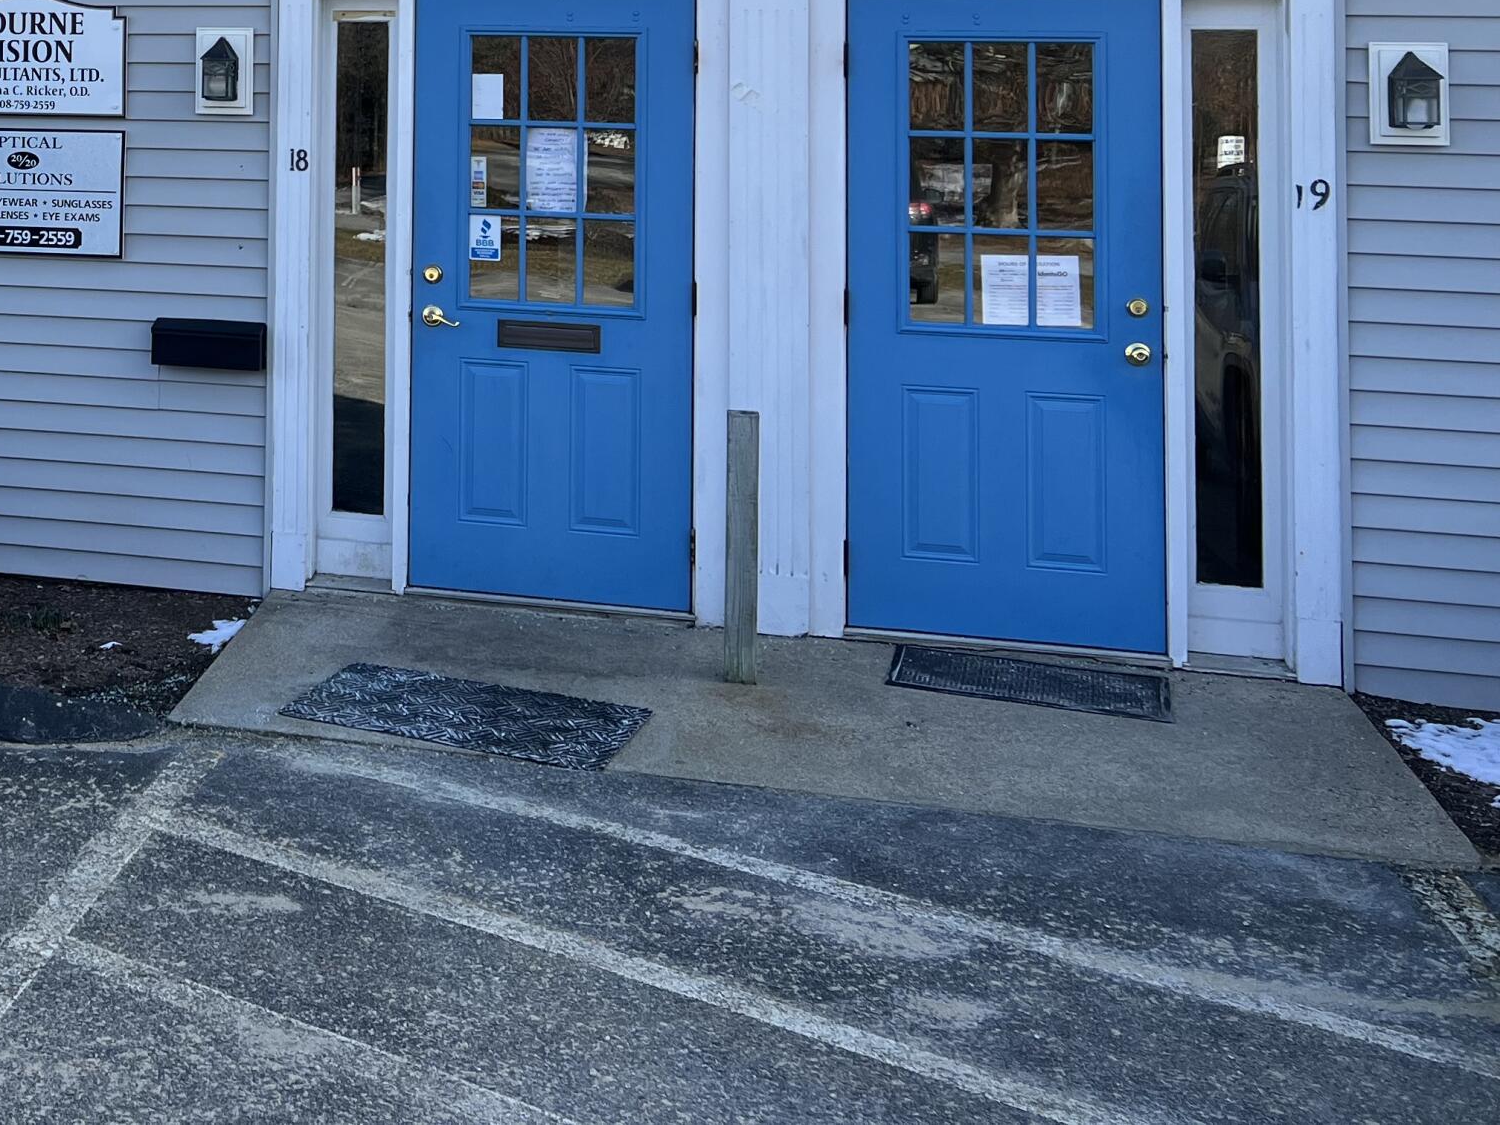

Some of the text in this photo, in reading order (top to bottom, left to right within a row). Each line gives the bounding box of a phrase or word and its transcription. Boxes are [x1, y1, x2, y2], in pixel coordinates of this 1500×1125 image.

[69, 68, 104, 83] LTD.
[12, 86, 23, 96] C.
[26, 85, 67, 97] Ricker,
[69, 86, 91, 97] O.D.
[11, 154, 37, 167] 20/20
[289, 148, 309, 172] 18
[1296, 179, 1330, 211] 19
[51, 199, 113, 209] SUNGLASSES
[42, 212, 60, 221] EYE
[64, 213, 100, 222] EXAMS
